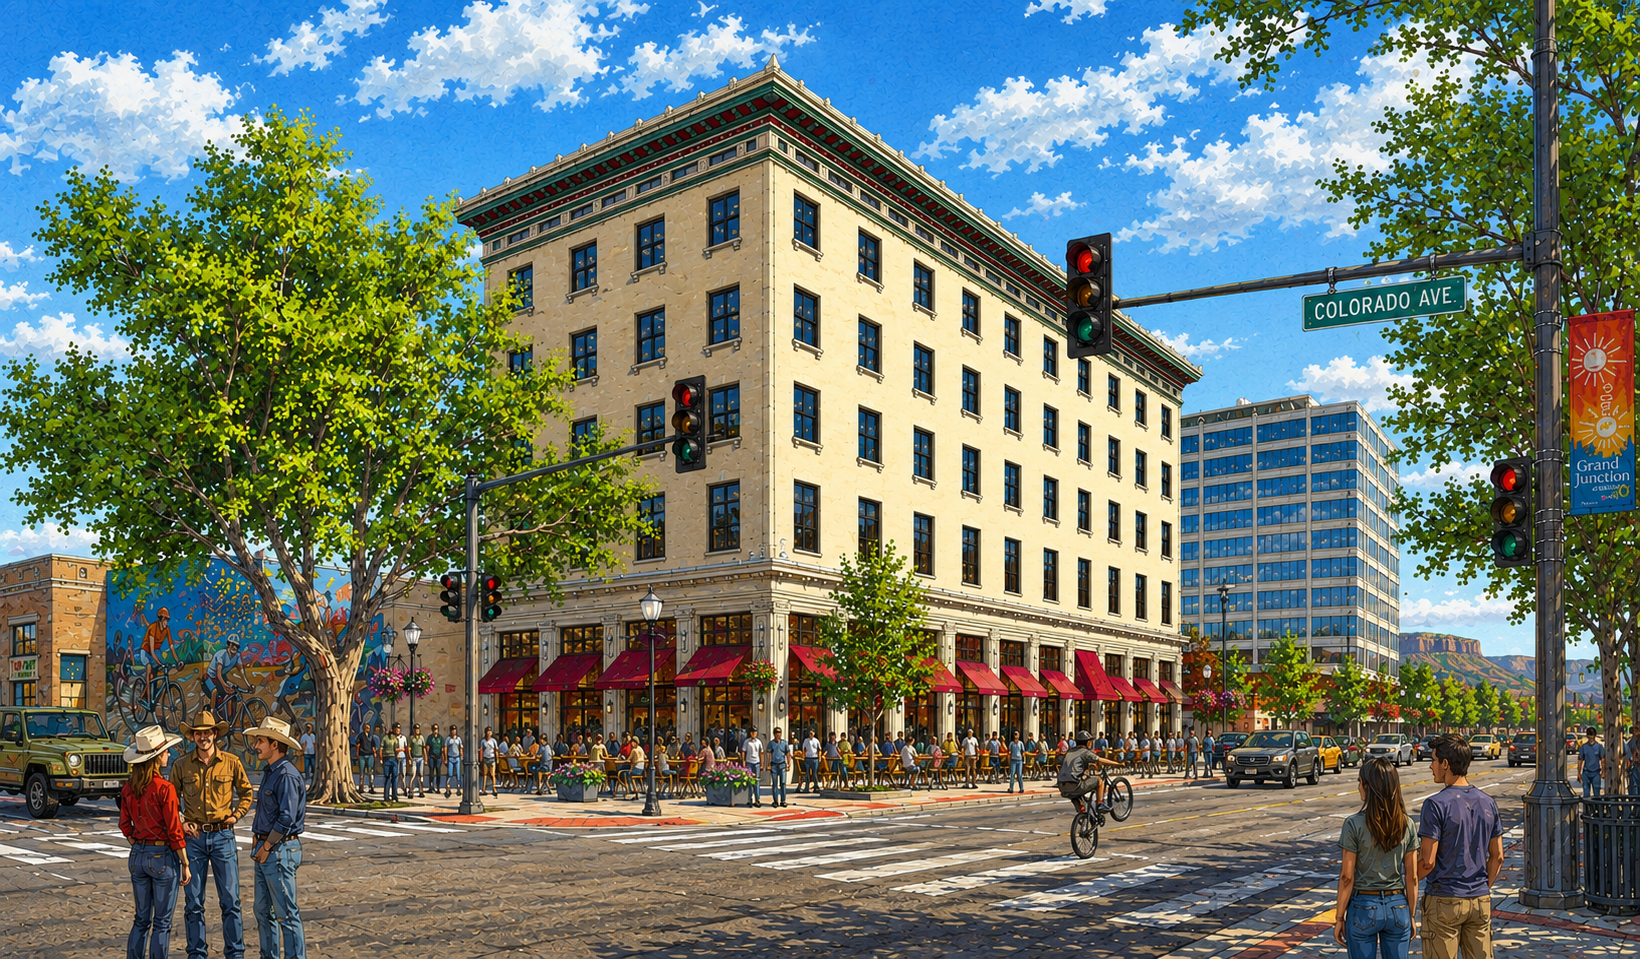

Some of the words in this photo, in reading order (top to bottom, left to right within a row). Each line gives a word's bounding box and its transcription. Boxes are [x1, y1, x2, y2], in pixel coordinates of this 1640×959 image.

[1314, 291, 1410, 320] COLORADO
[1418, 286, 1457, 307] AVE.
[1576, 456, 1619, 472] Grand
[1574, 470, 1630, 489] Junction
